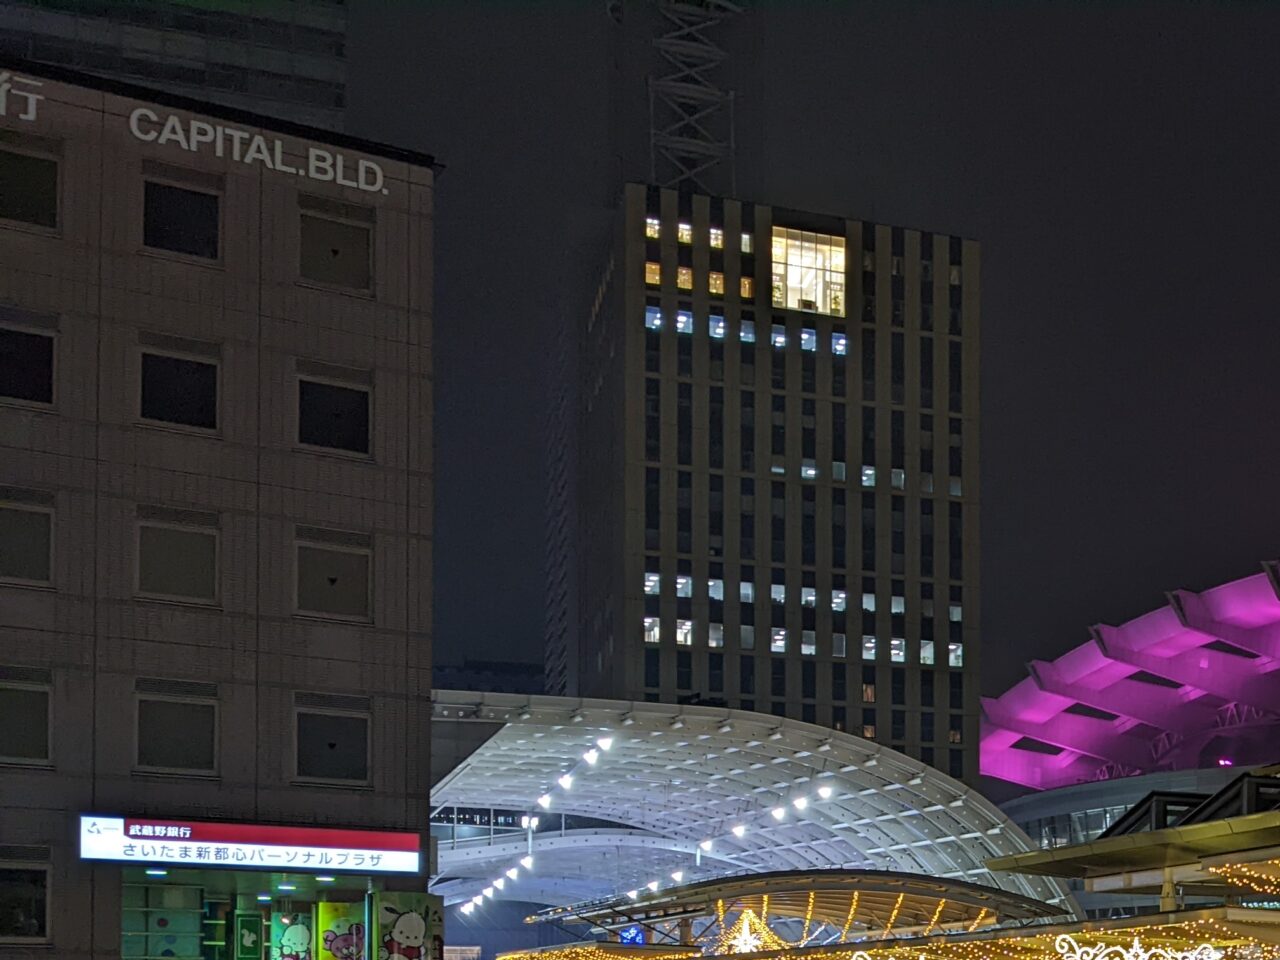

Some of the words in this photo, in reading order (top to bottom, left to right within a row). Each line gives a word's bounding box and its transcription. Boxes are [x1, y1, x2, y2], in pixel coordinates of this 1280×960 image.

[129, 824, 192, 838] 武蔵野銀行
[123, 843, 384, 867] さいたま新都心パーソナルプラザ
